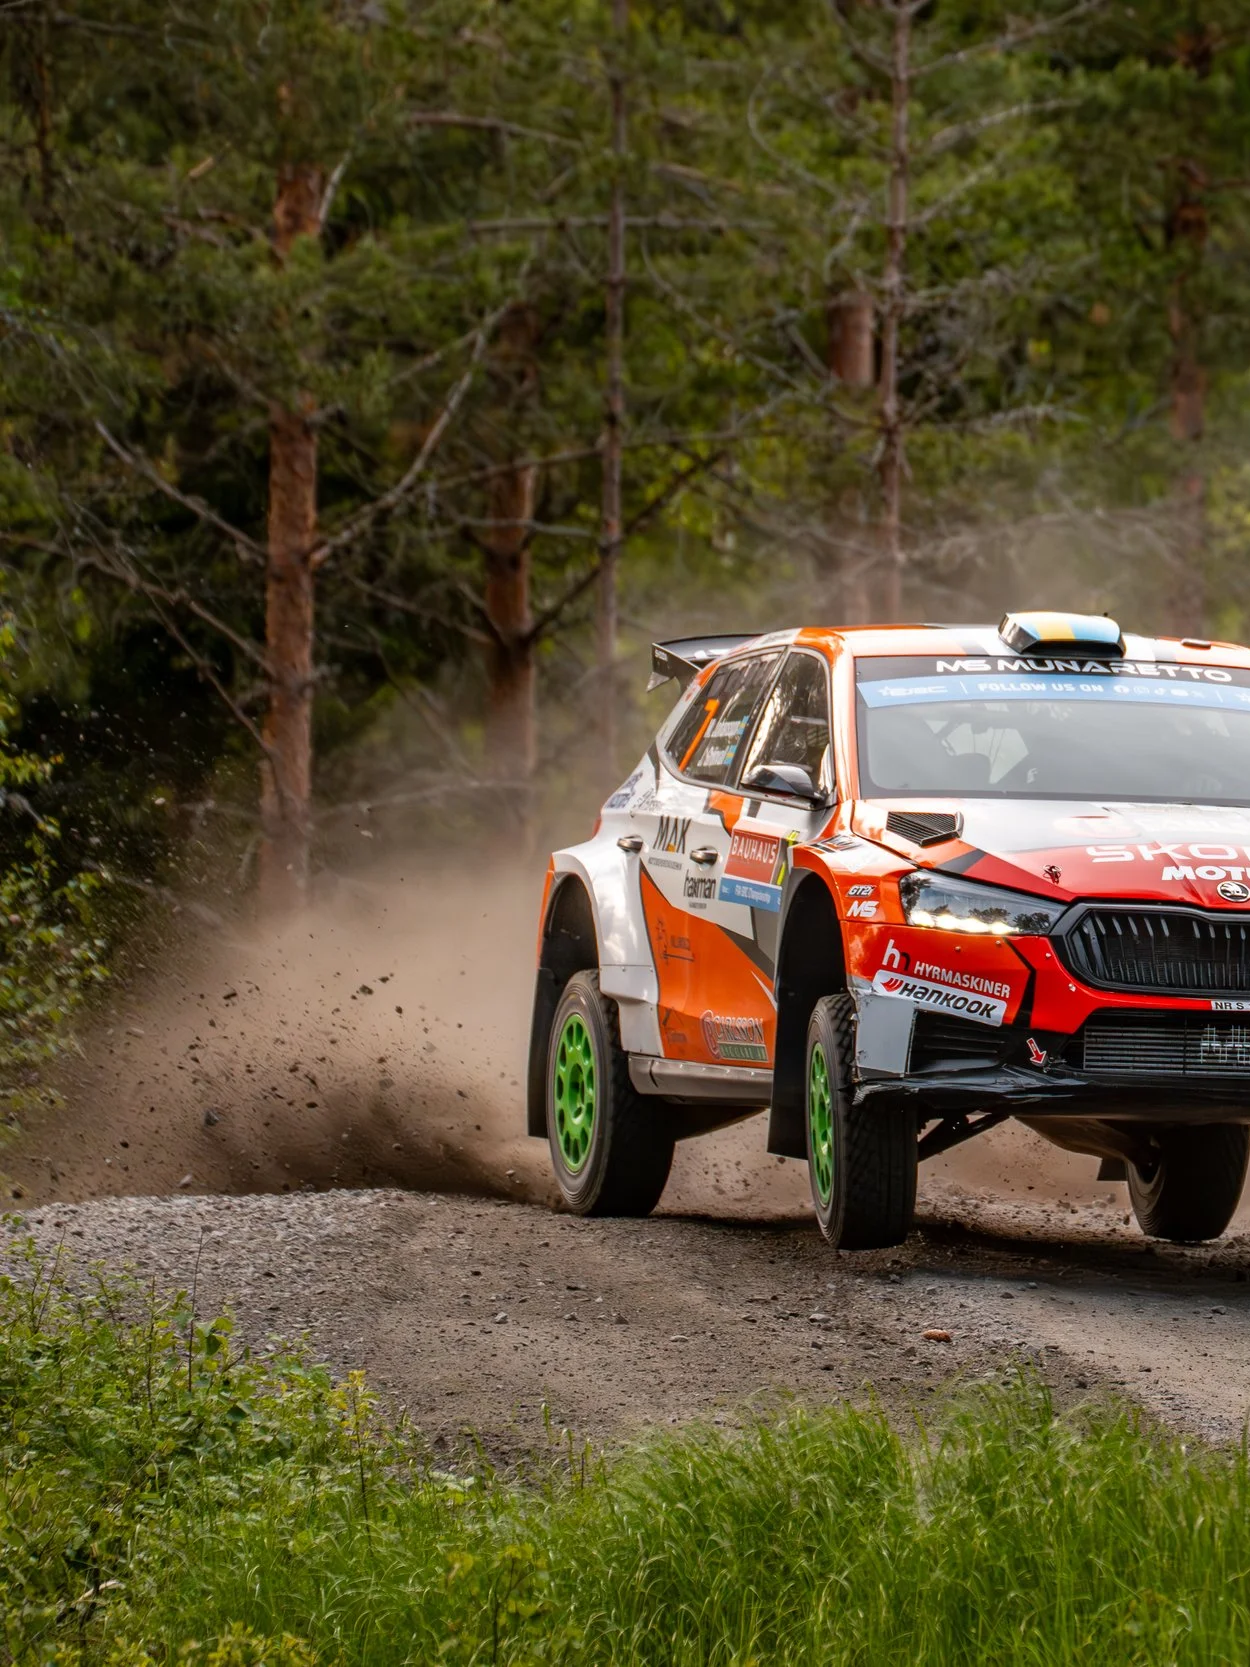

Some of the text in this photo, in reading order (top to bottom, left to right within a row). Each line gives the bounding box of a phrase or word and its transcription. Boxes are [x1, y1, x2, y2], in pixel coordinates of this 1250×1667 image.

[936, 659, 1232, 682] MS MUNARETTO
[977, 682, 1104, 693] FOLLOW US ON
[653, 815, 692, 855] MAK
[730, 834, 778, 864] BAUHAUS
[846, 900, 879, 917] MS
[914, 960, 1011, 998] HYRMASKINER
[1215, 1002, 1233, 1010] NR
[1236, 1002, 1245, 1010] S
